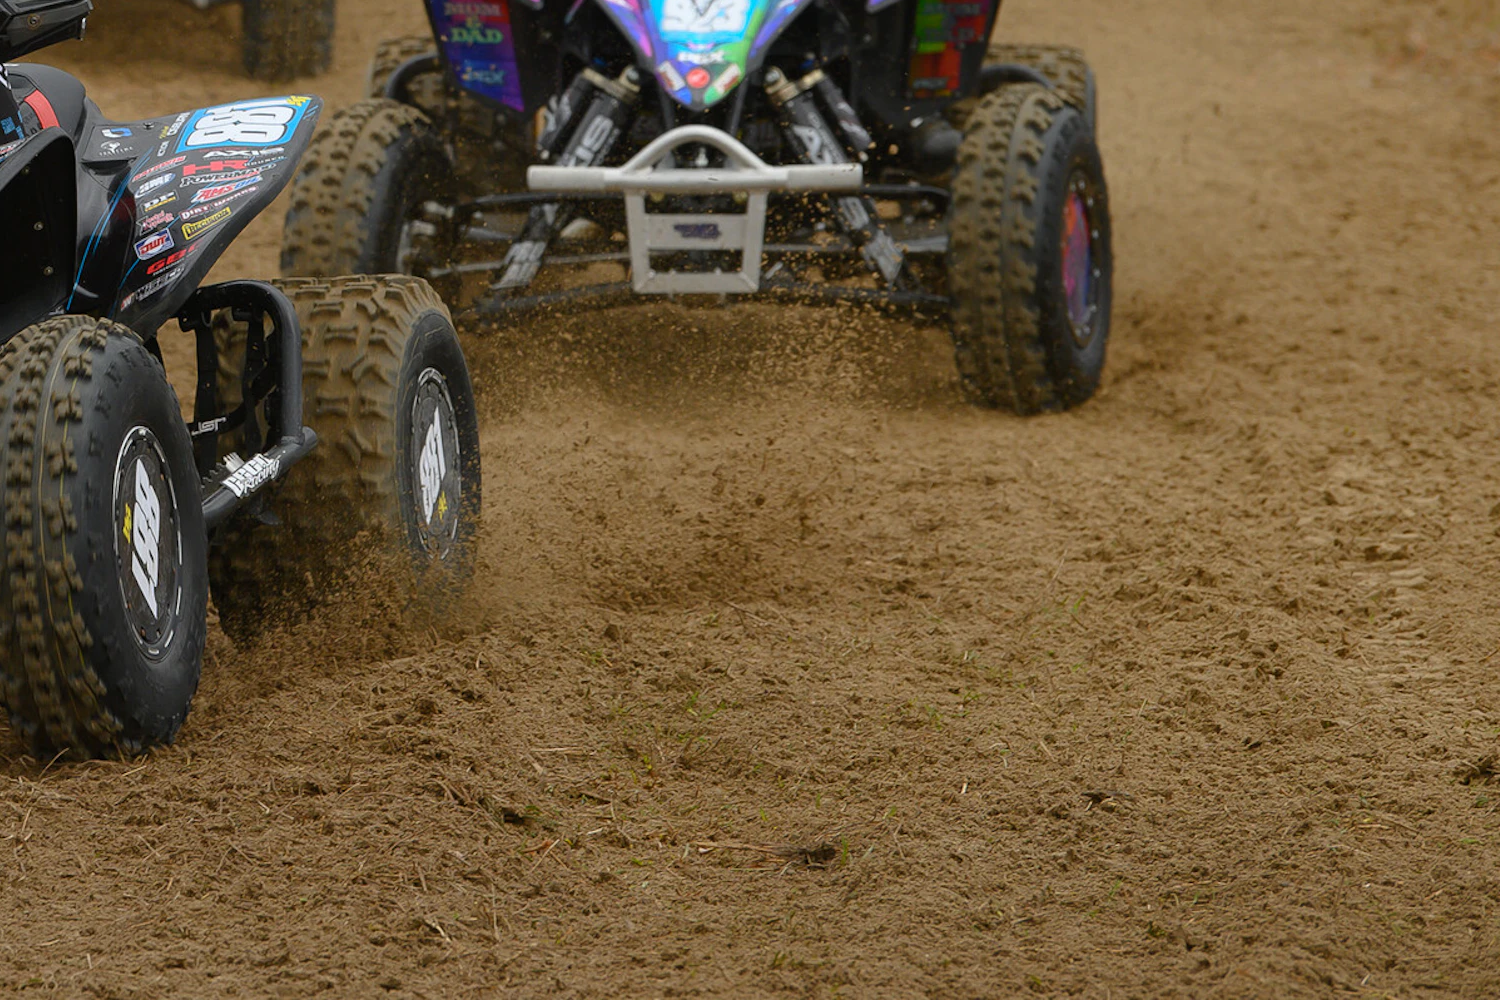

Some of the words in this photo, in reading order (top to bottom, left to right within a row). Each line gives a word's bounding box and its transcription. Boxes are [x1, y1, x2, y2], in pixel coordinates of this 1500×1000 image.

[451, 28, 504, 44] DAD
[186, 101, 296, 147] 881
[197, 176, 262, 200] AMSOIL
[132, 458, 161, 620] 881
